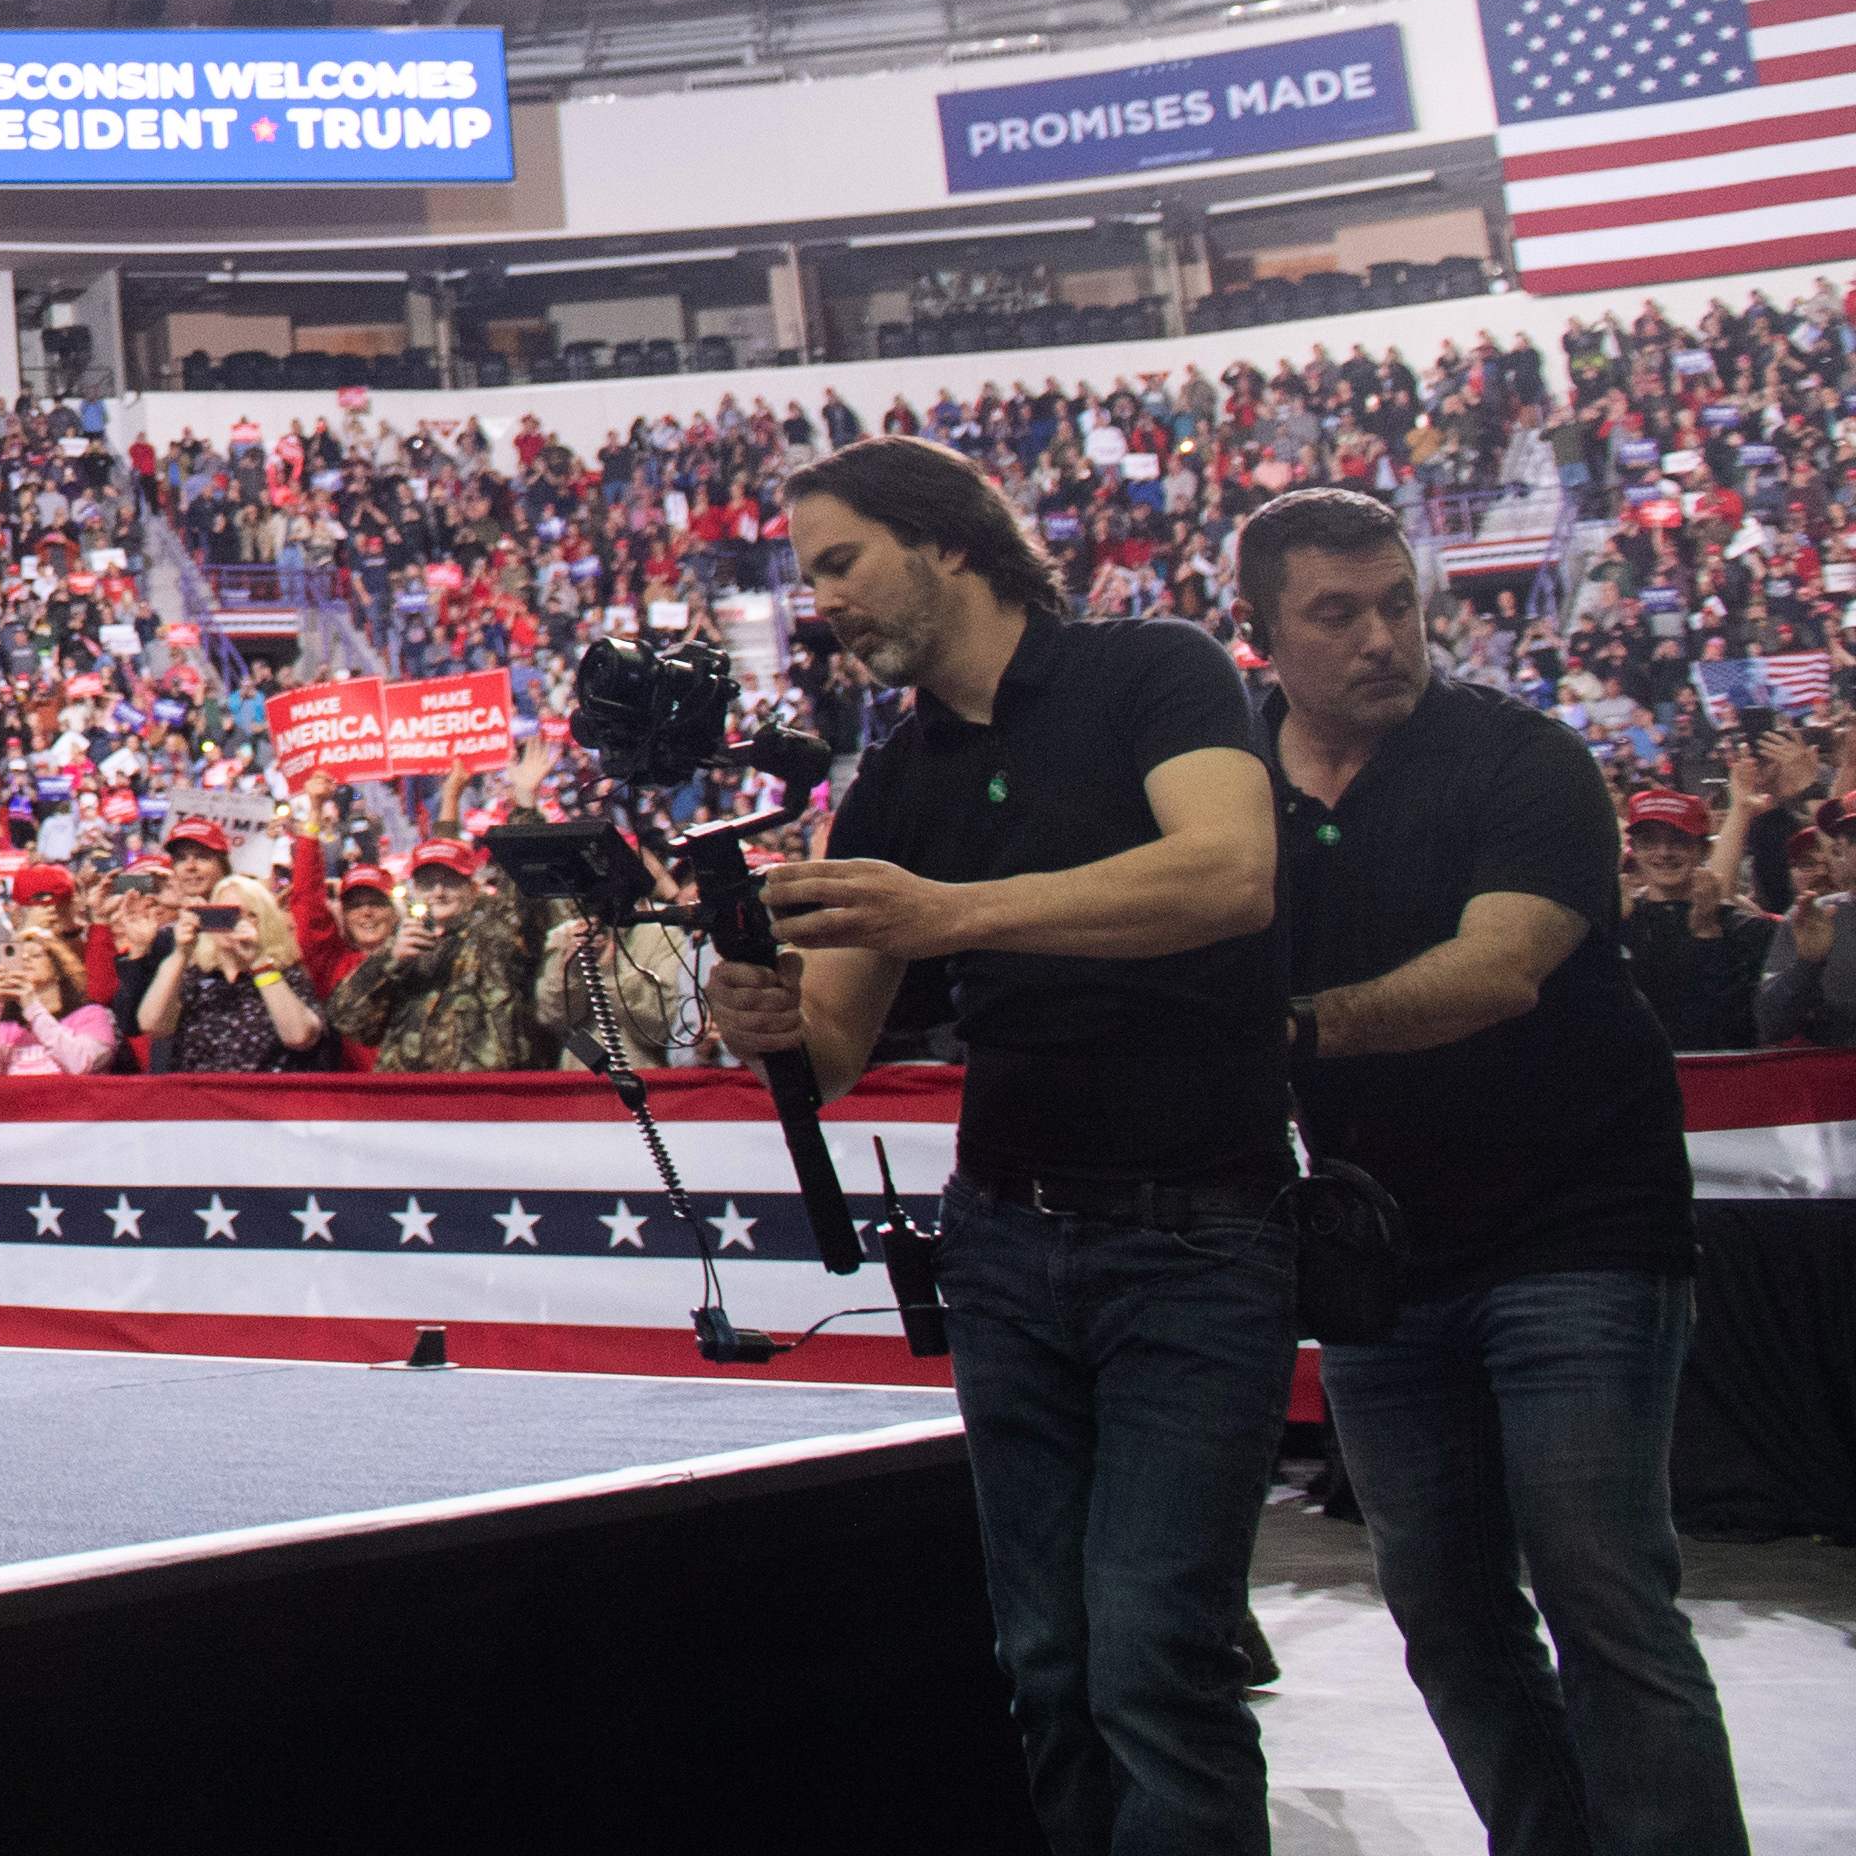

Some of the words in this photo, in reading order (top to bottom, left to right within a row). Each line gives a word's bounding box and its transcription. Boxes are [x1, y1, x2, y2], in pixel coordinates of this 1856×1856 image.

[202, 60, 477, 101] WELCOMES
[968, 89, 1216, 158] PROMISES
[1226, 62, 1377, 120] MADE
[285, 107, 492, 150] TRUMP
[290, 696, 342, 721] MAKE
[420, 689, 473, 712] MAKE
[389, 705, 507, 740] AMERICA
[319, 742, 385, 765] AGAIN
[389, 739, 449, 760] GREAT
[452, 733, 509, 755] AGAIN
